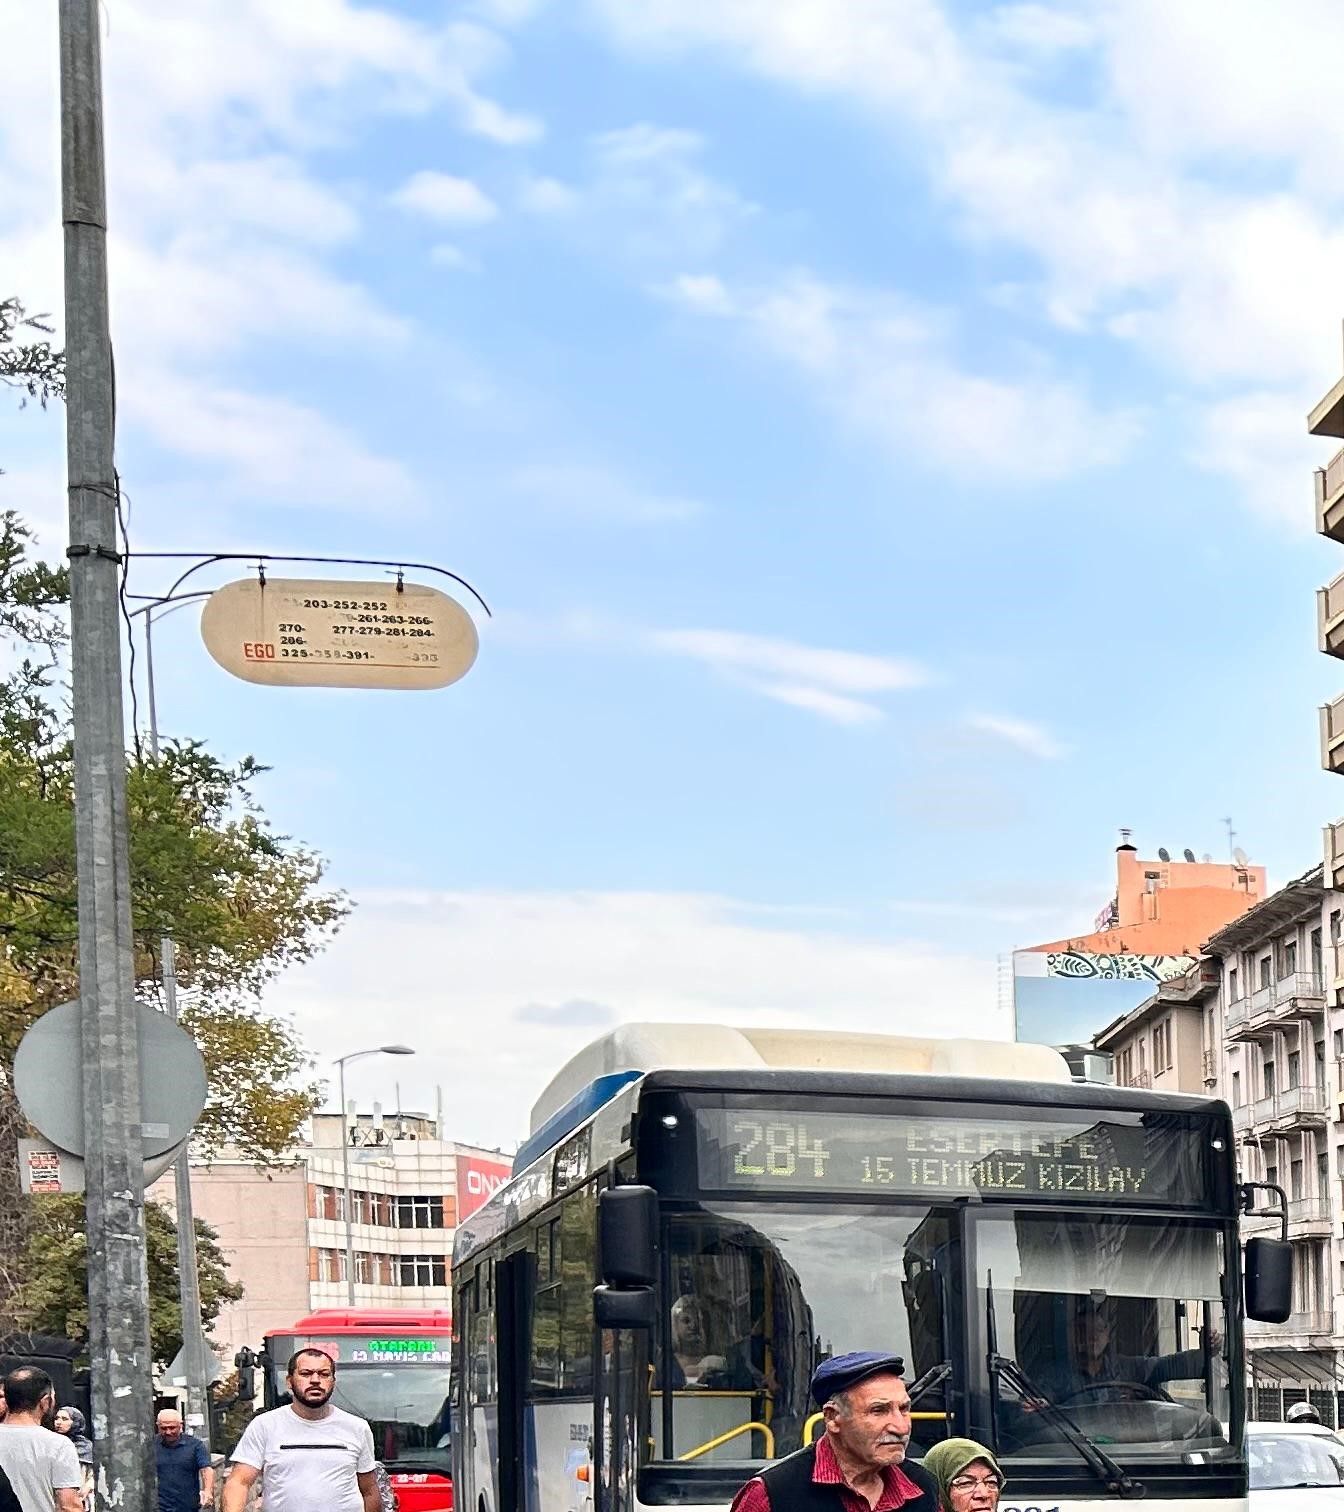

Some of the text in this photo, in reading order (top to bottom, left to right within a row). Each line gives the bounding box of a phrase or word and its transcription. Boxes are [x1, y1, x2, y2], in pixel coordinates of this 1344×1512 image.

[243, 642, 276, 660] EGO
[733, 1120, 831, 1178] 284
[860, 1155, 896, 1185] 15
[906, 1156, 1027, 1190] TEMMUZ
